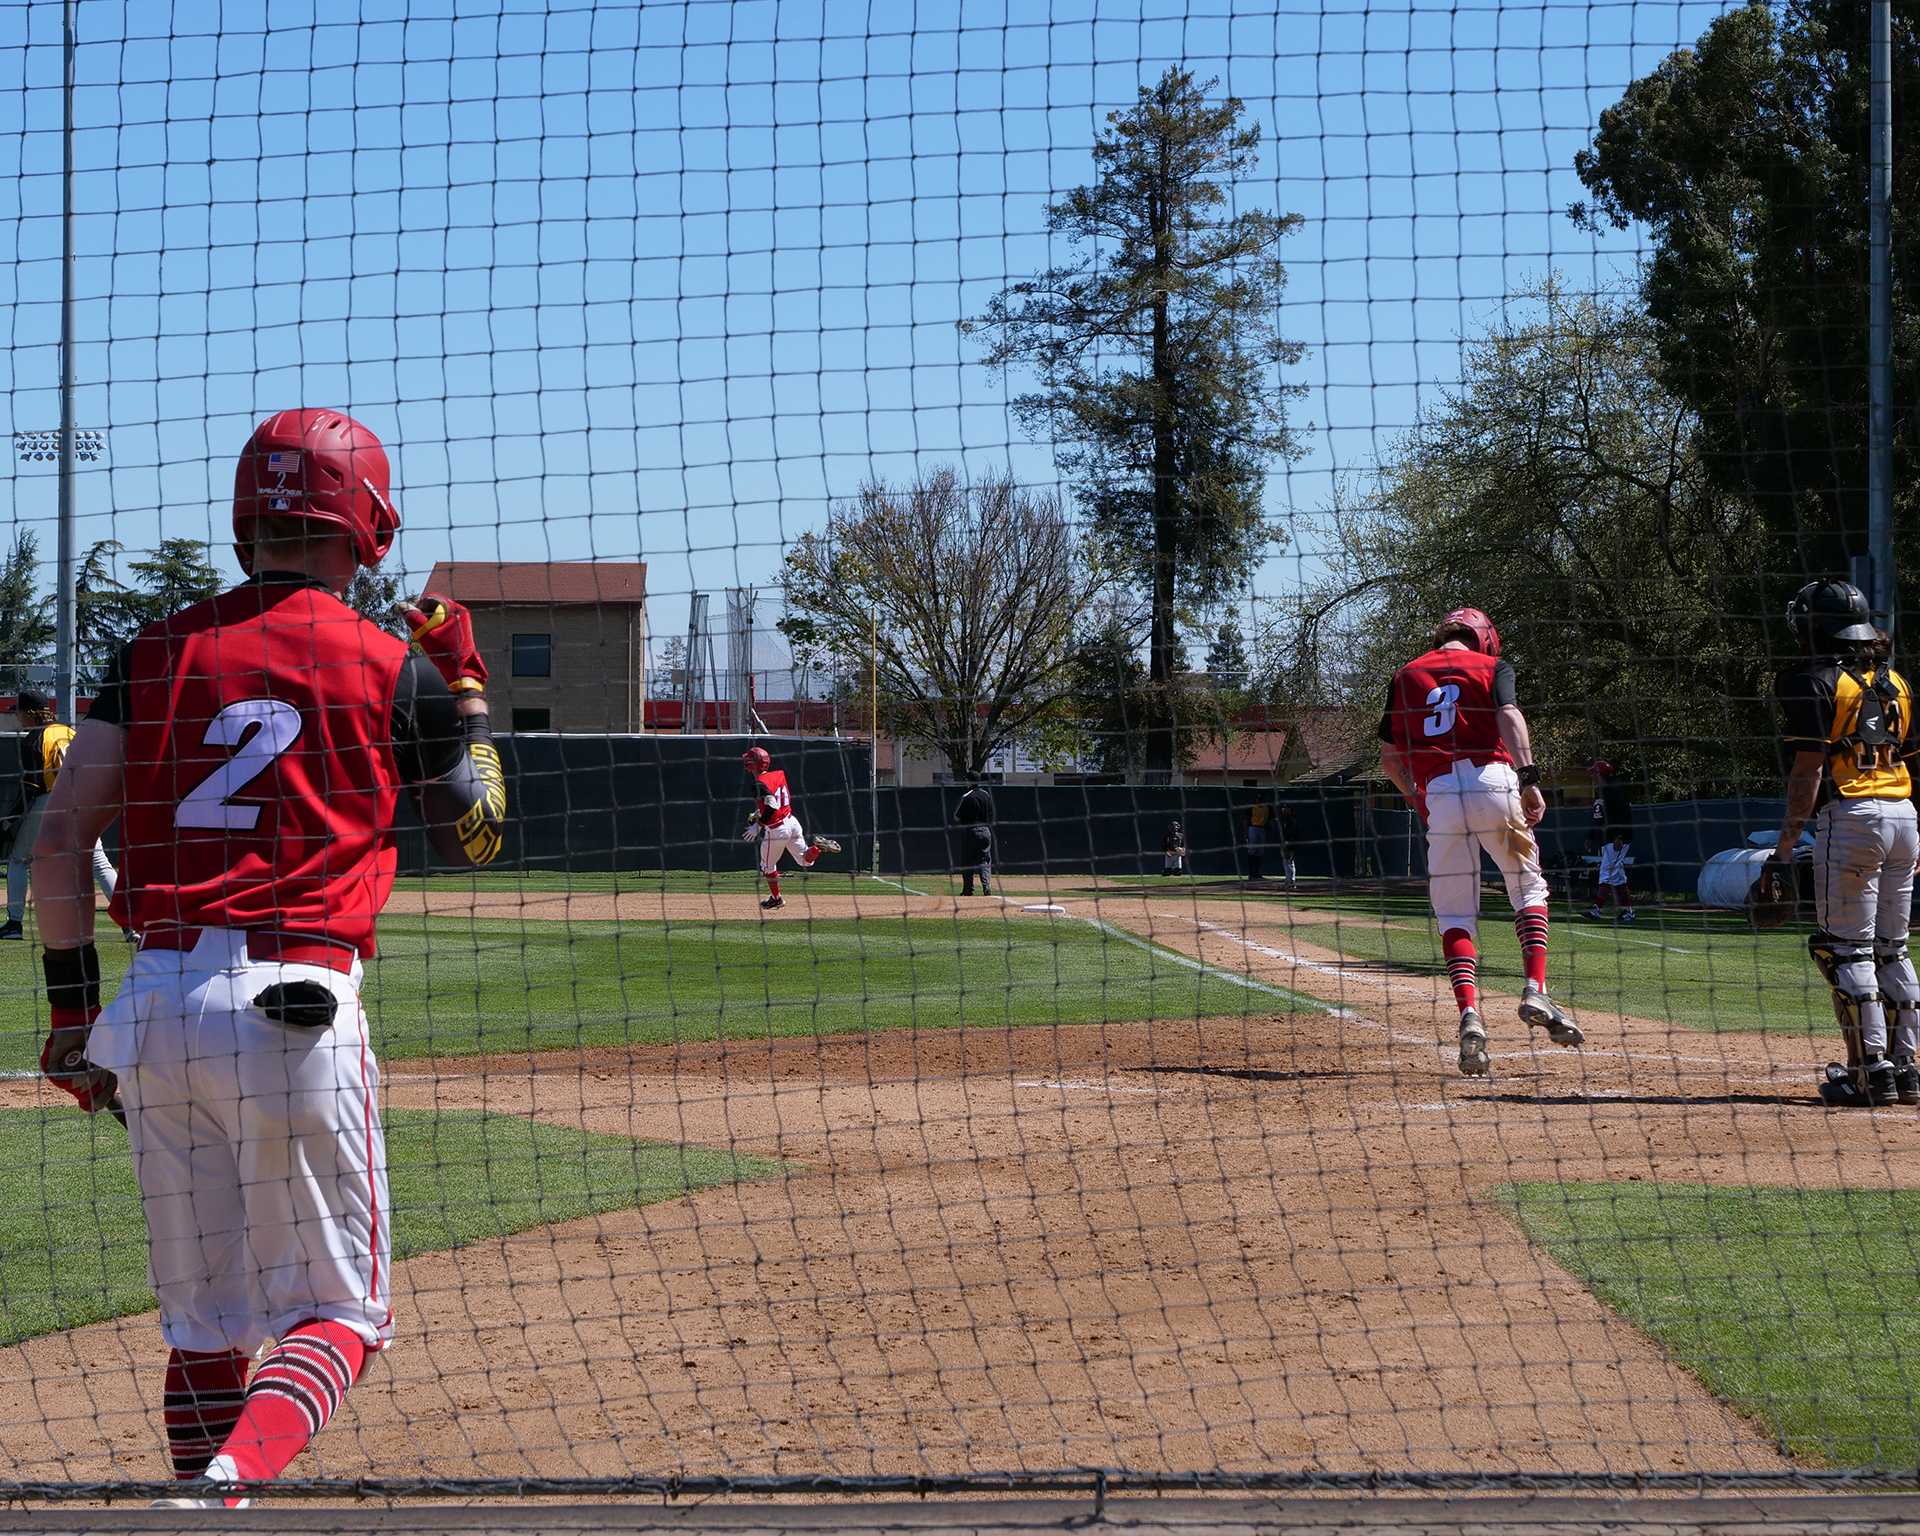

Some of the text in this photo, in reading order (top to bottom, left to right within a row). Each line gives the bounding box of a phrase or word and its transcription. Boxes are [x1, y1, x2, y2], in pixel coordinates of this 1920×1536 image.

[276, 471, 287, 489] 2
[1423, 683, 1462, 738] 3
[174, 698, 304, 831] 2
